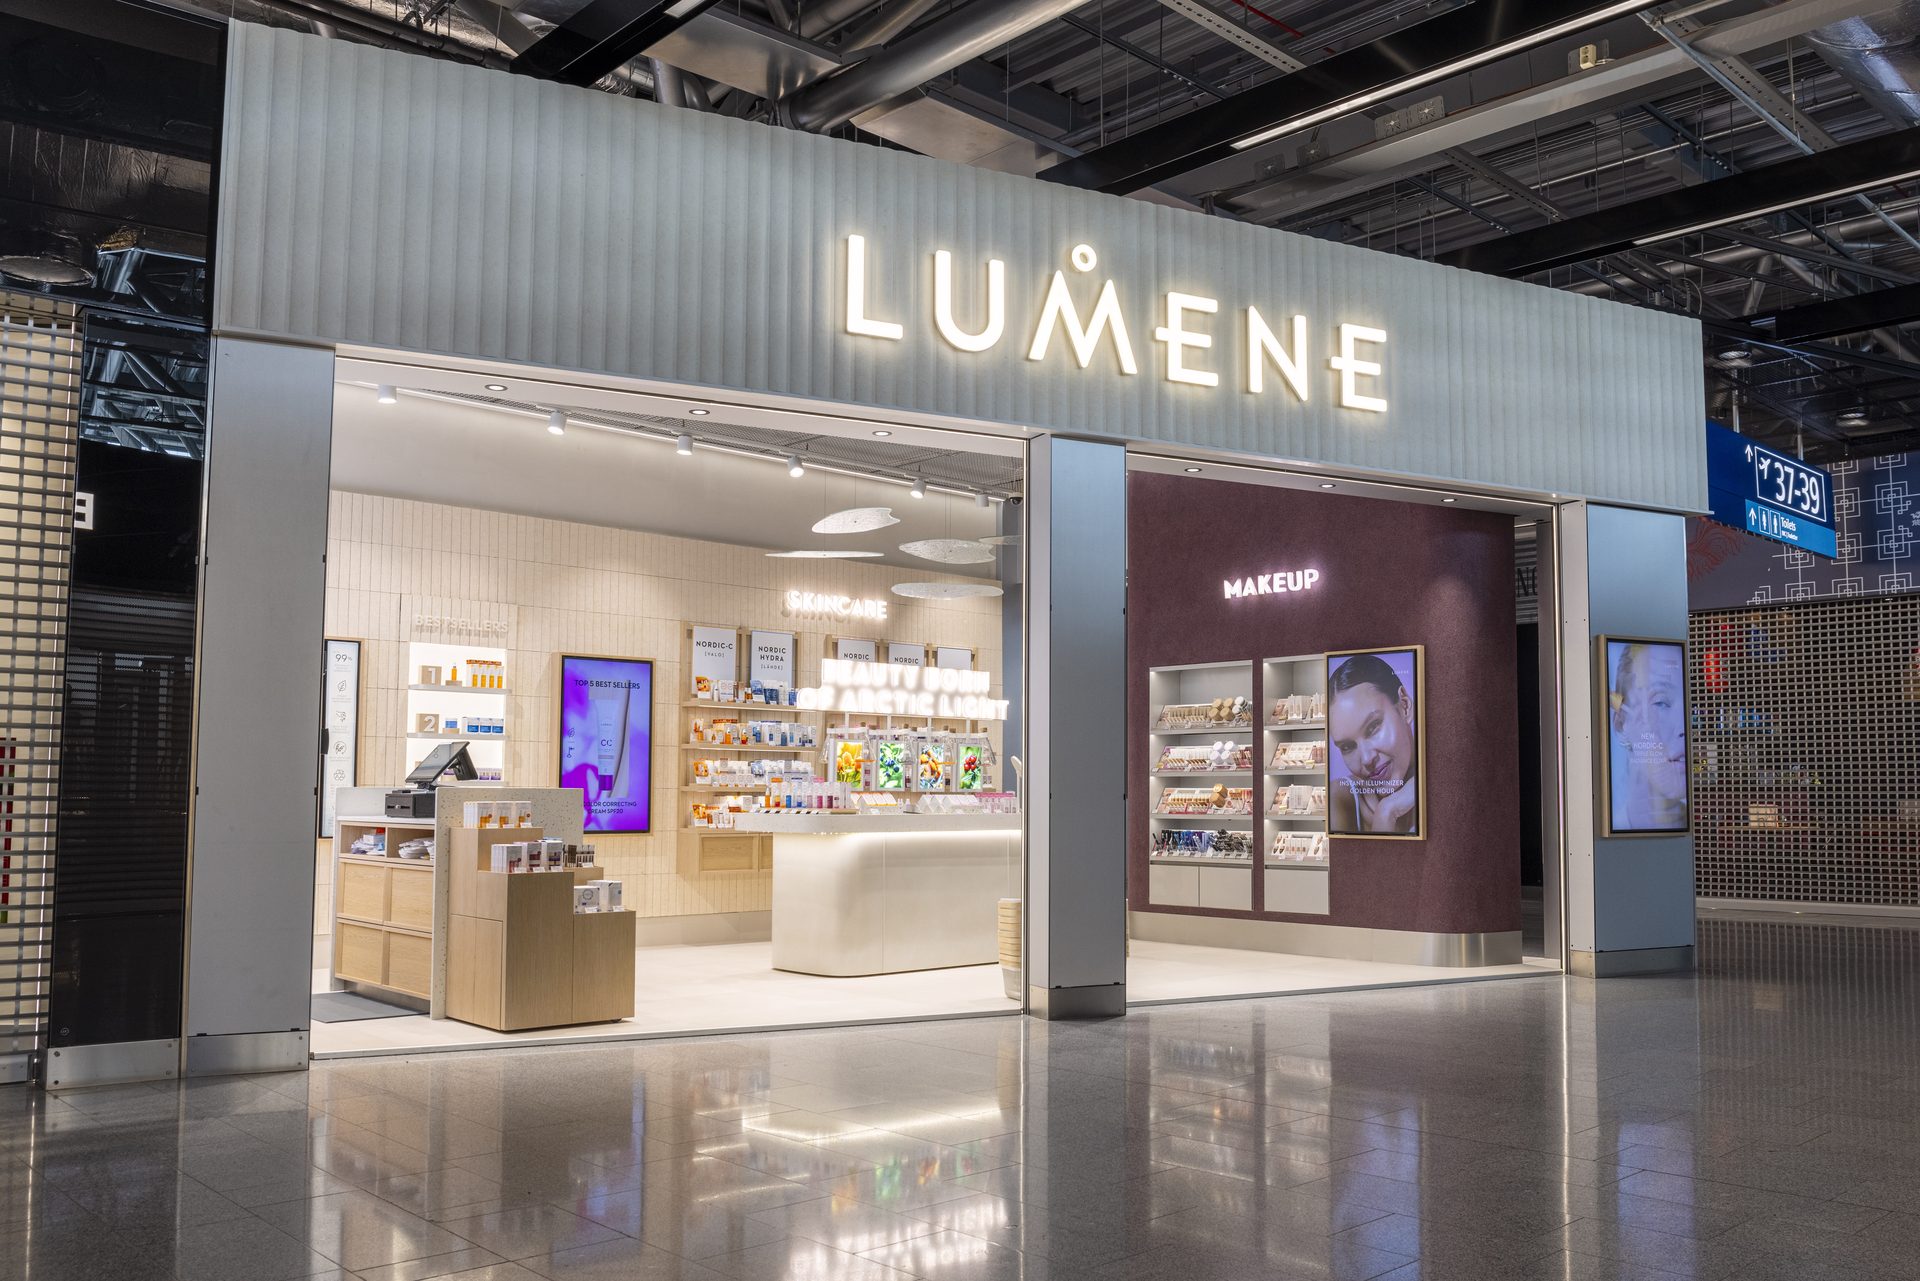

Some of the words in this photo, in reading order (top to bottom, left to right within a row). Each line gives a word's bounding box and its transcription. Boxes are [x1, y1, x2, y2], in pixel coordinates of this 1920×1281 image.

[845, 233, 1388, 412] LUMENE
[1774, 461, 1820, 515] 37-39
[1780, 516, 1797, 532] Toilets
[1223, 568, 1320, 599] MAKEUP
[786, 590, 888, 619] SKINCARE
[415, 614, 509, 633] BESTSELLERS
[695, 640, 734, 650] NORDIC-C
[758, 646, 787, 655] NORDIC
[760, 654, 785, 663] HYDRA
[843, 652, 870, 661] NORDIC
[894, 656, 919, 665] NORDIC
[427, 667, 437, 684] 1
[575, 679, 588, 687] TOP
[595, 680, 612, 688] BEST
[612, 681, 641, 690] SELLERS
[423, 715, 436, 732] 2
[1641, 732, 1655, 740] NEW
[600, 739, 613, 747] CC
[1365, 779, 1404, 787] ILLUMINIZER
